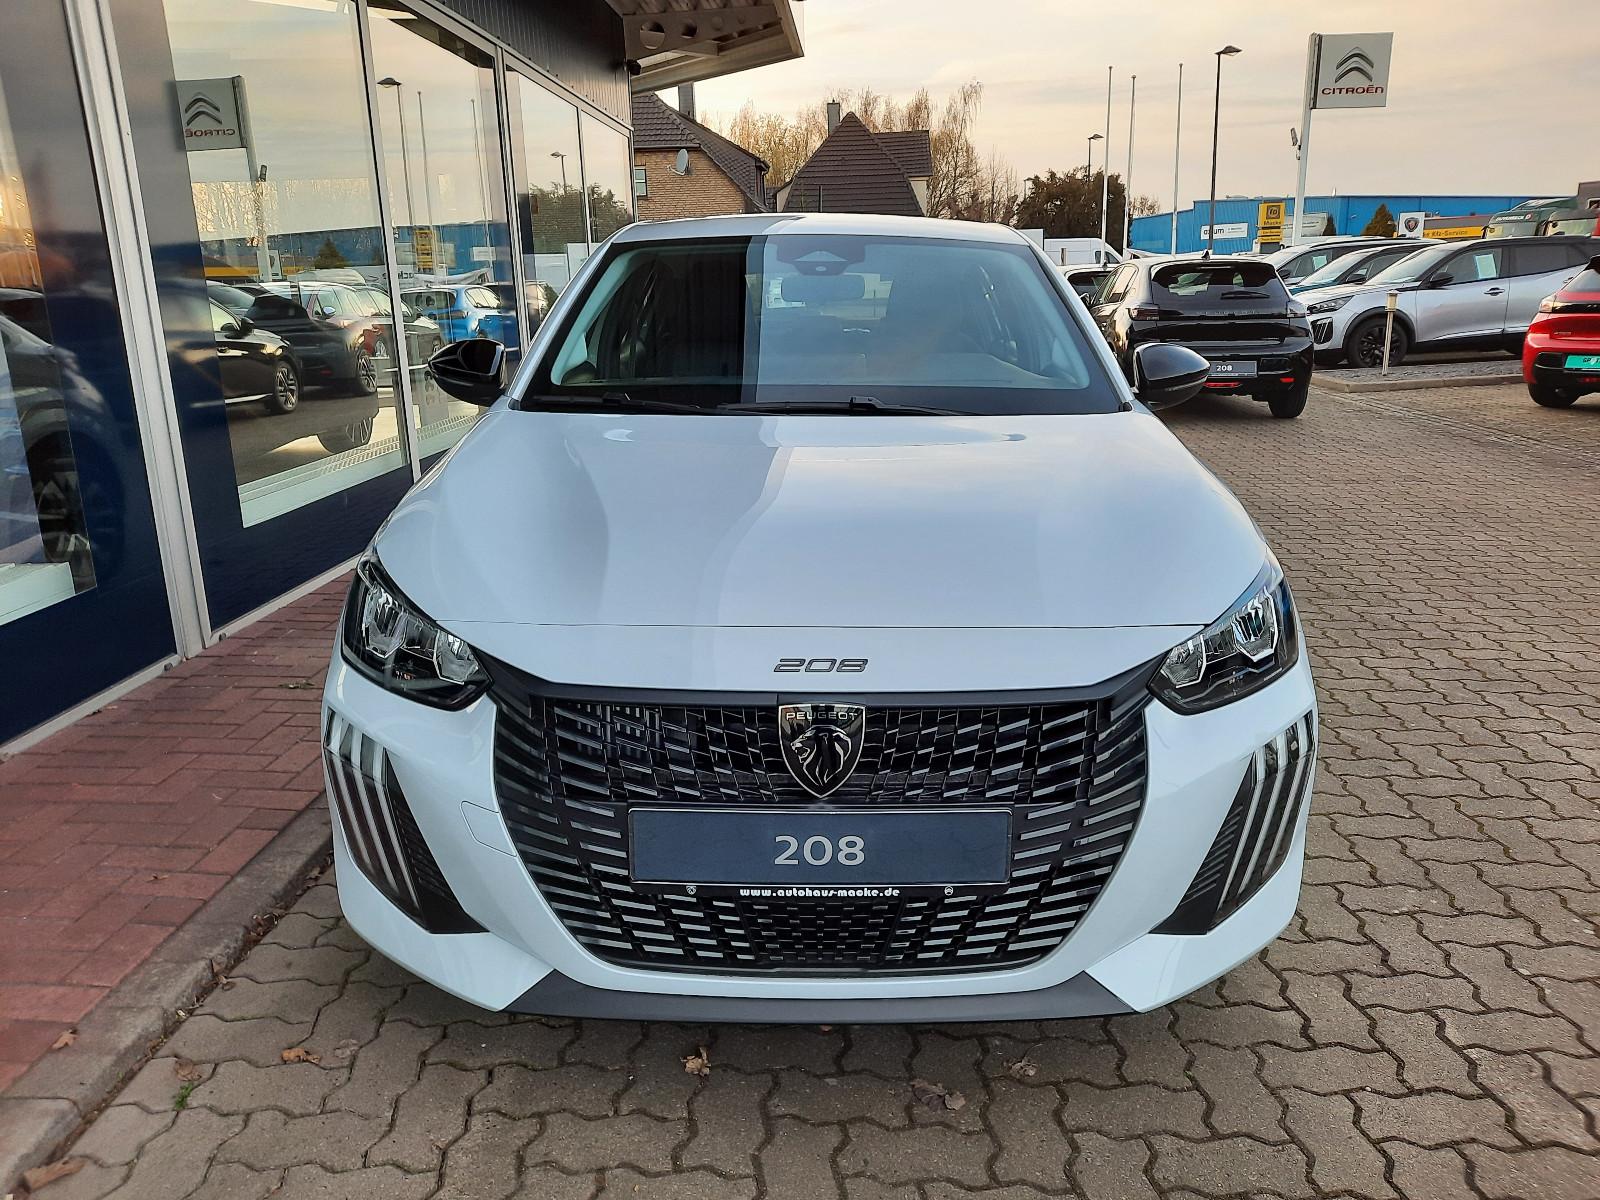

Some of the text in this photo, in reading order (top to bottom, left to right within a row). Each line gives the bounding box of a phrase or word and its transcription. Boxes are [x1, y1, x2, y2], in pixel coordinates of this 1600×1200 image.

[773, 658, 868, 672] 208
[786, 711, 858, 721] PEUGEOT
[774, 835, 865, 866] 208
